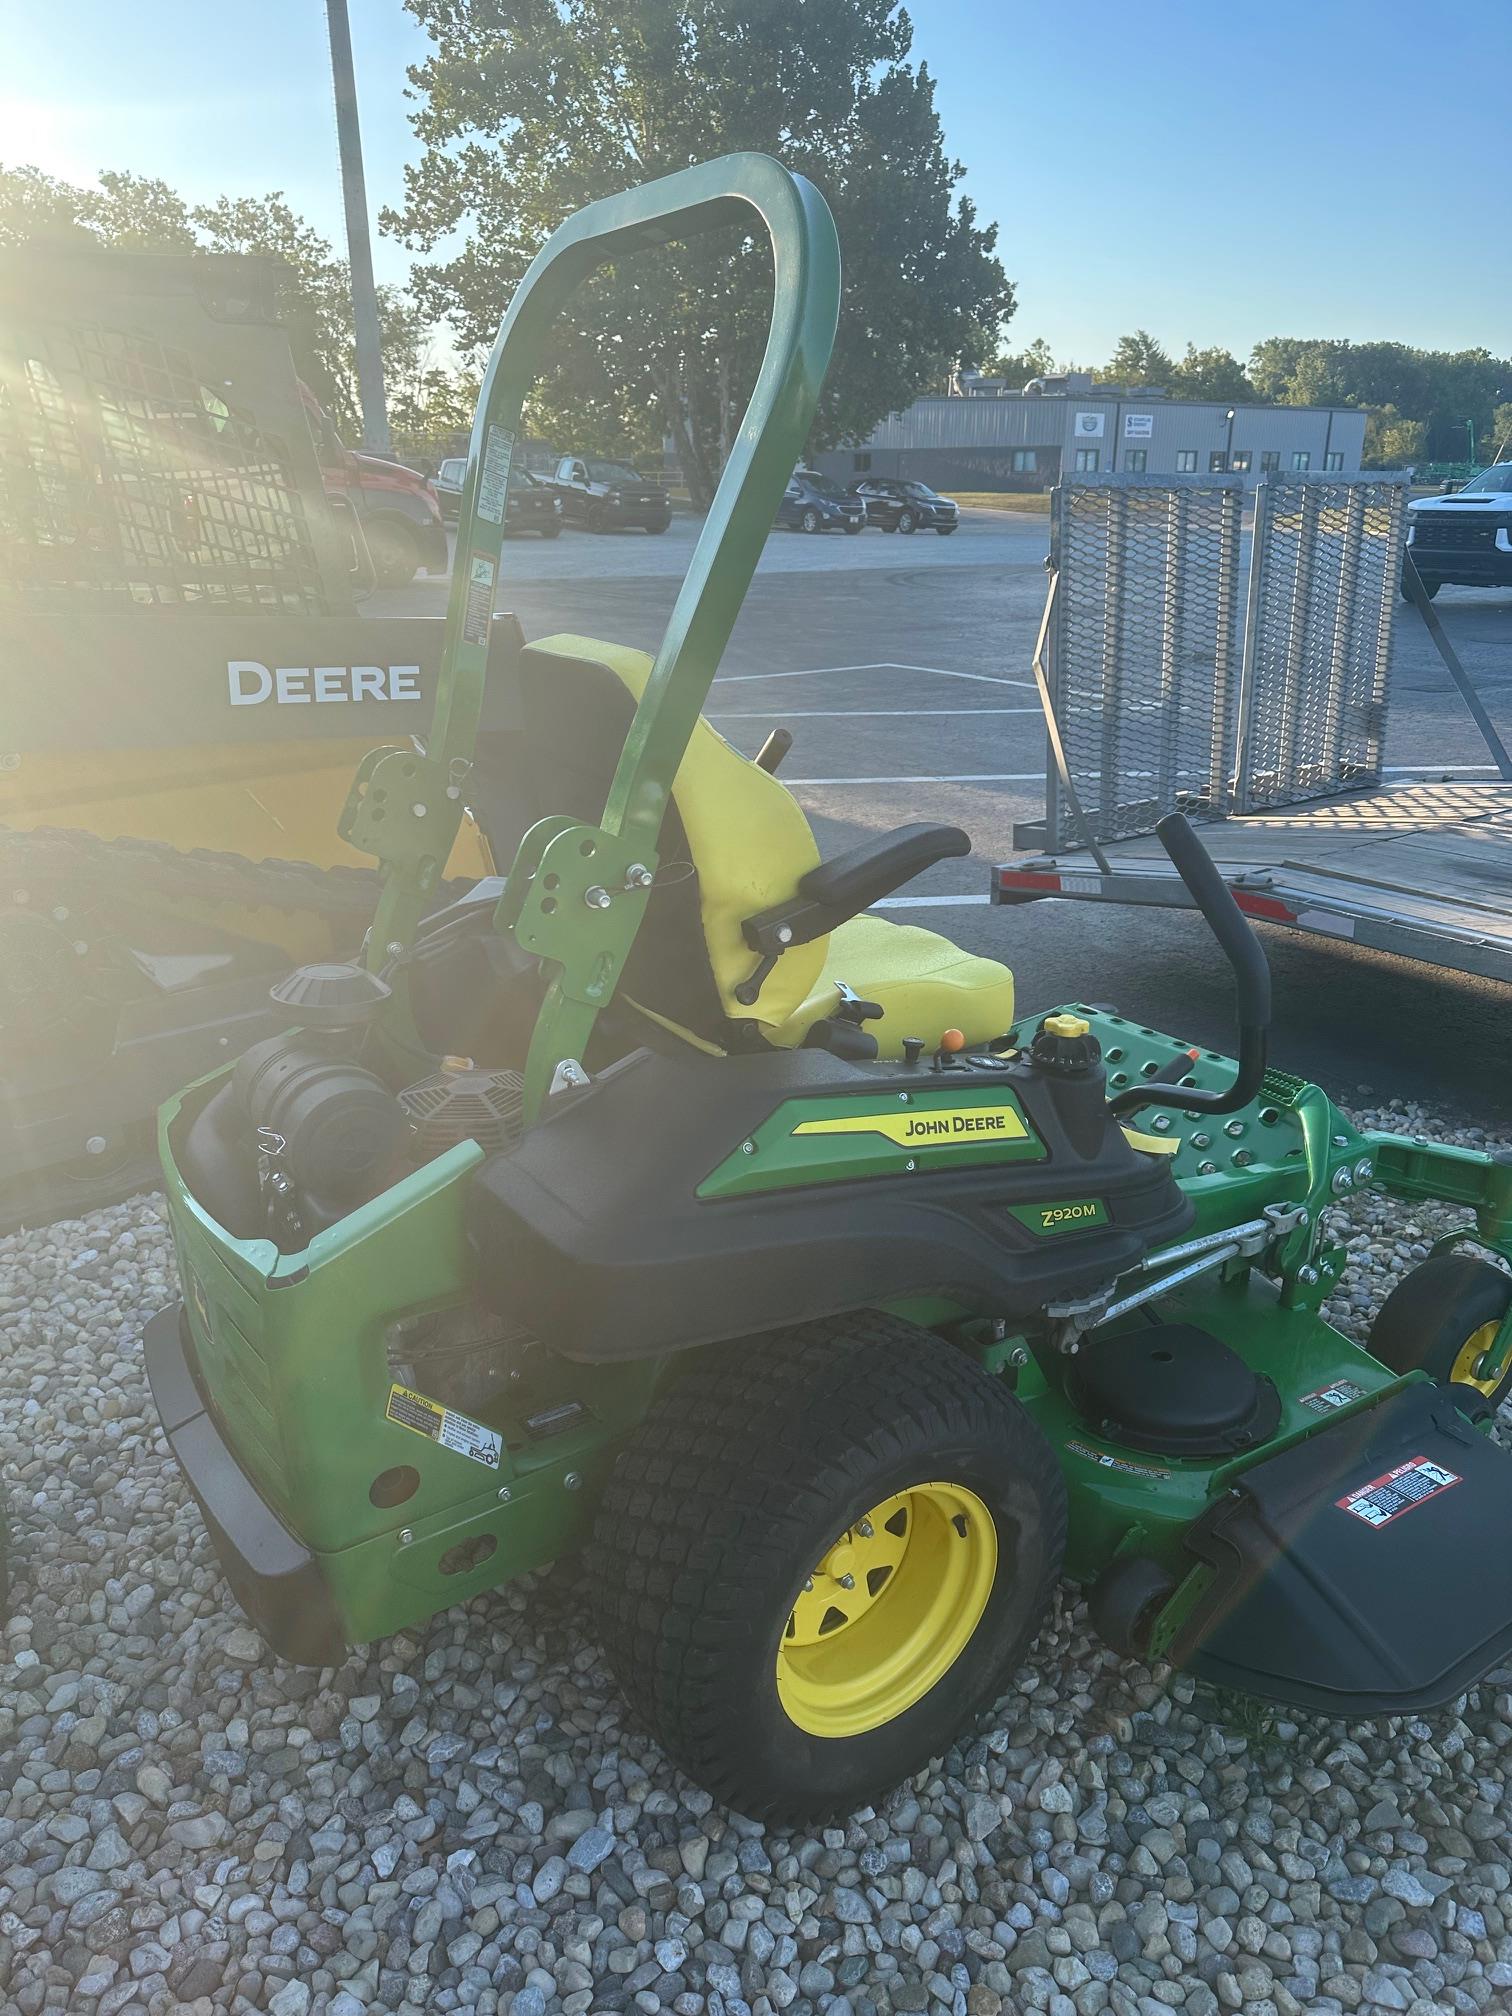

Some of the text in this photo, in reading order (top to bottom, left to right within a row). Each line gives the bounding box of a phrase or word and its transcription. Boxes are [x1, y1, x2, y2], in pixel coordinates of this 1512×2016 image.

[227, 661, 421, 706] DEERE
[904, 1115, 1006, 1137] JOHN DEERE
[1040, 1203, 1097, 1227] Z920M
[408, 1391, 433, 1410] CAUTION
[1395, 1461, 1418, 1478] PELIGRO
[1352, 1484, 1377, 1499] DANGER
